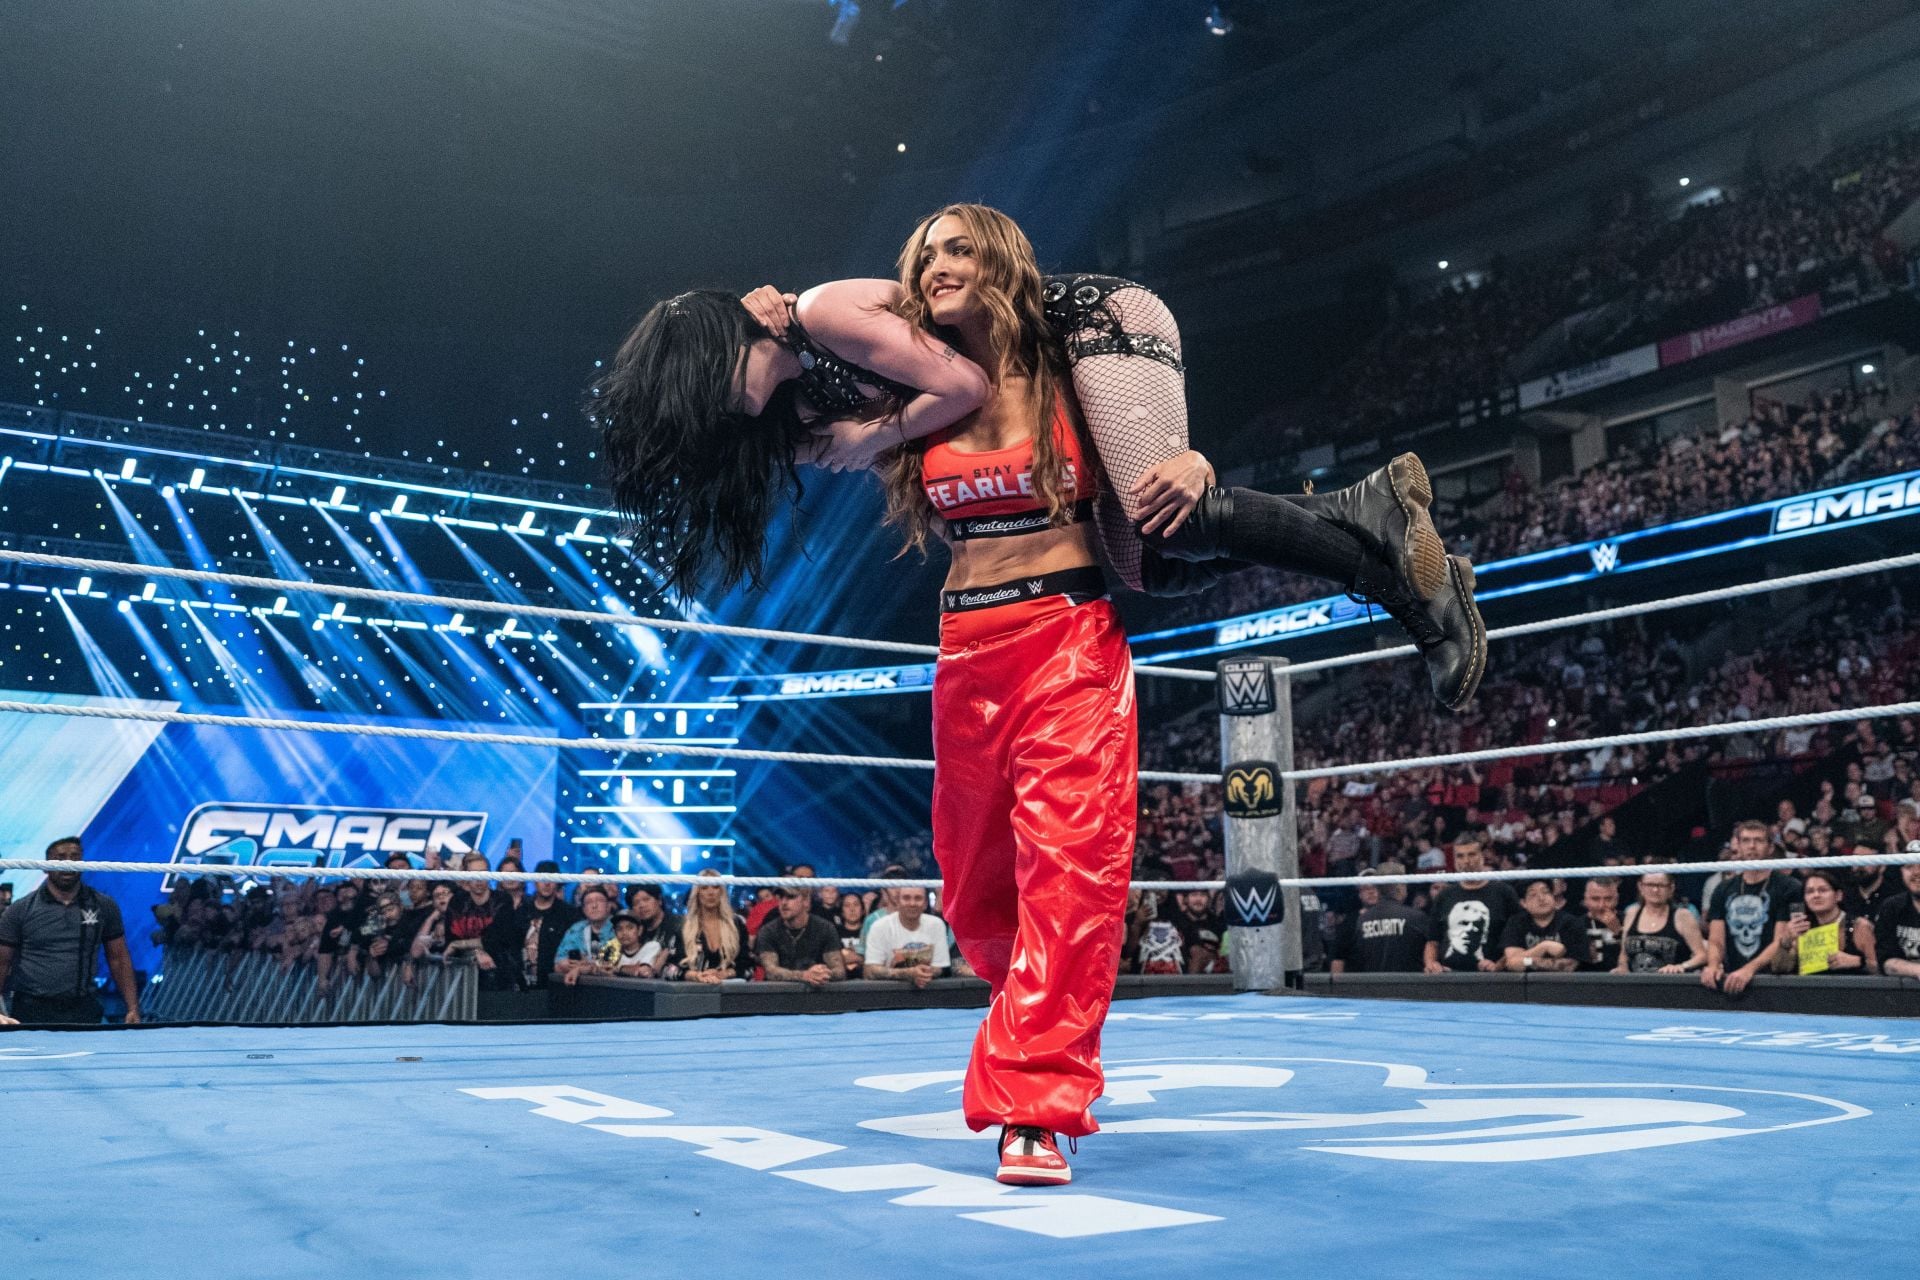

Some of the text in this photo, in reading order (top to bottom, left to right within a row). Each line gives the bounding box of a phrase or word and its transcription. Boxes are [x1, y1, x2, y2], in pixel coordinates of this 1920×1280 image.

[973, 465, 1012, 479] STAY
[926, 464, 1076, 508] FEARLES
[966, 516, 1050, 534] Contenders
[960, 587, 1021, 606] Contenders
[185, 809, 481, 855] SMACK
[1362, 918, 1406, 938] SECURITY
